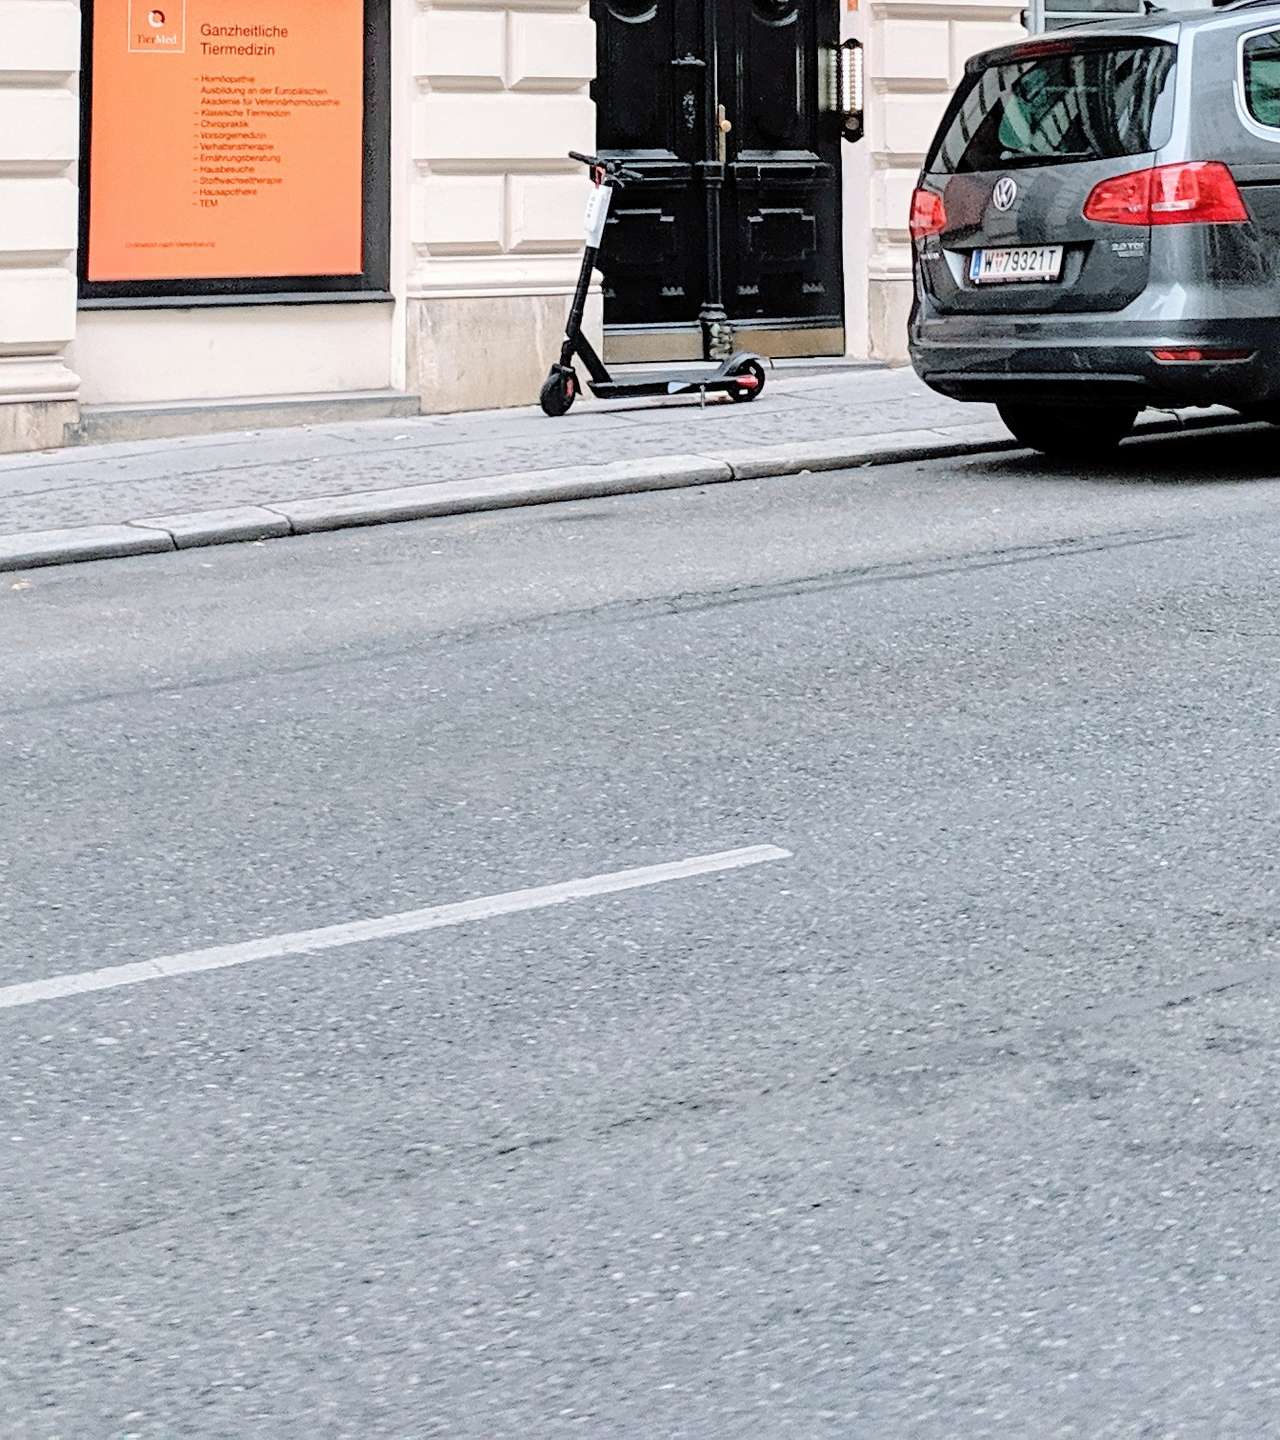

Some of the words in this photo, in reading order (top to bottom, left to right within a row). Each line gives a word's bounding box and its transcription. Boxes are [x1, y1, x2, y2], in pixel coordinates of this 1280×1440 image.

[199, 23, 289, 39] Ganzheitliche
[136, 33, 178, 45] TierMed
[199, 42, 276, 57] Tiermedizin
